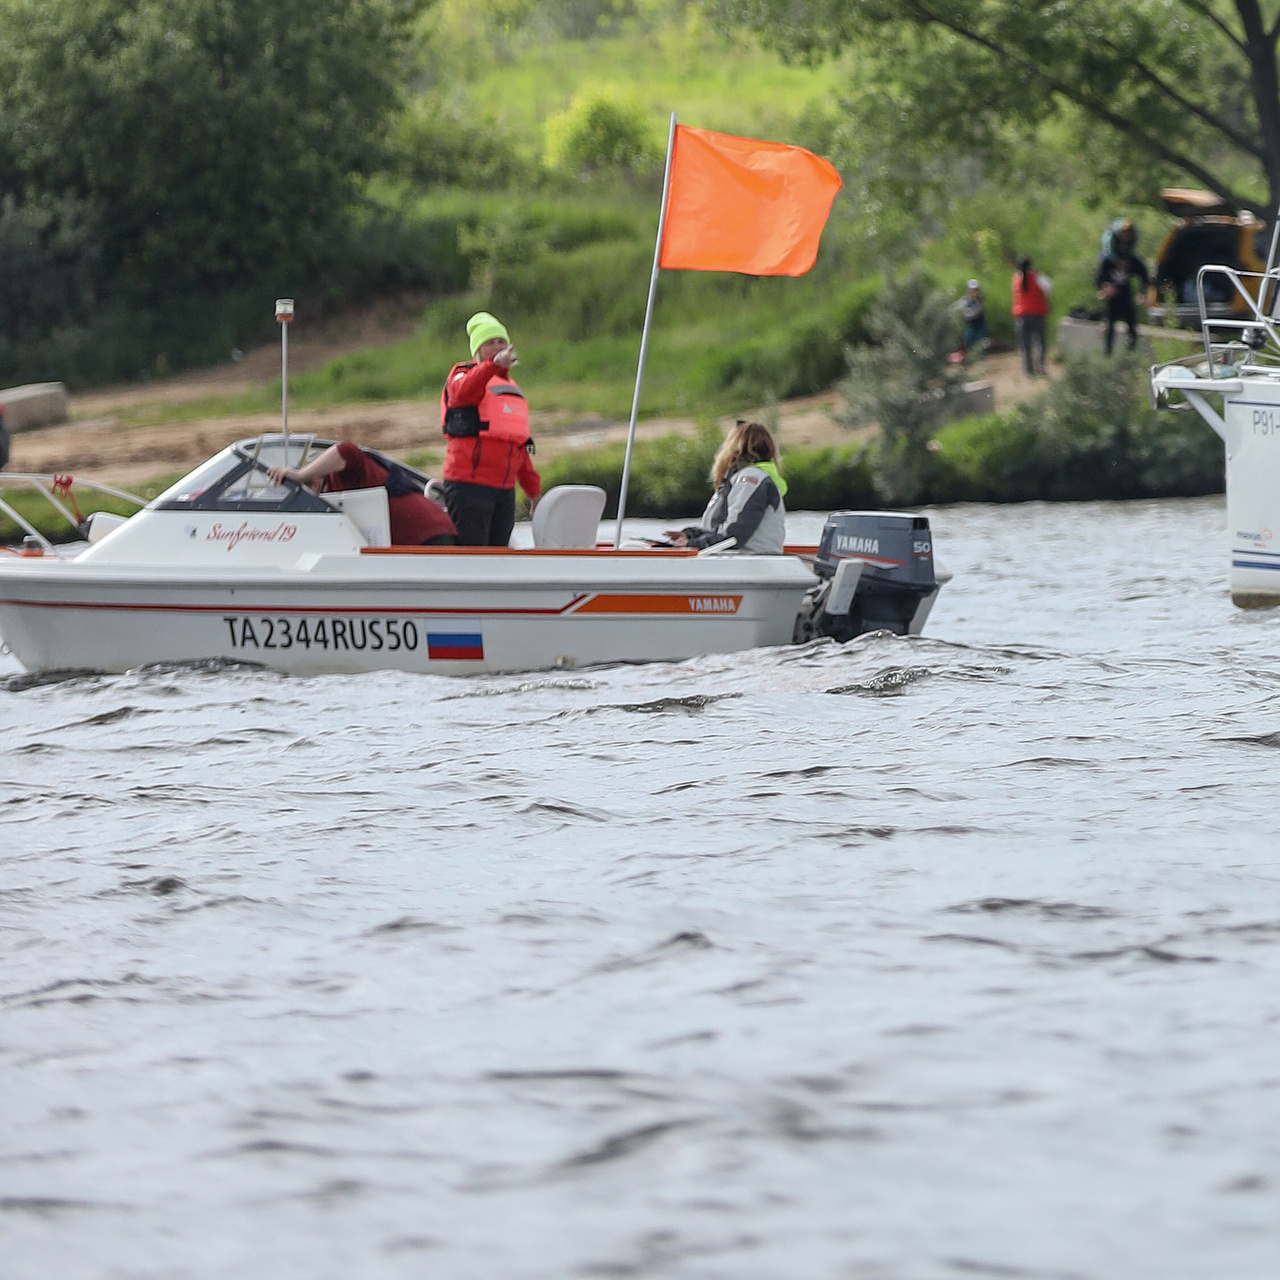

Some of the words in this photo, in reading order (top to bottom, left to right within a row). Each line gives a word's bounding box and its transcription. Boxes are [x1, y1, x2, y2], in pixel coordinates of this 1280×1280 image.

[206, 521, 285, 552] Sunfriend
[279, 525, 298, 543] 19
[836, 535, 880, 555] YAMAHA
[913, 541, 931, 553] 50
[688, 597, 736, 612] YAMAHA
[223, 617, 418, 651] TA2344RUS50
